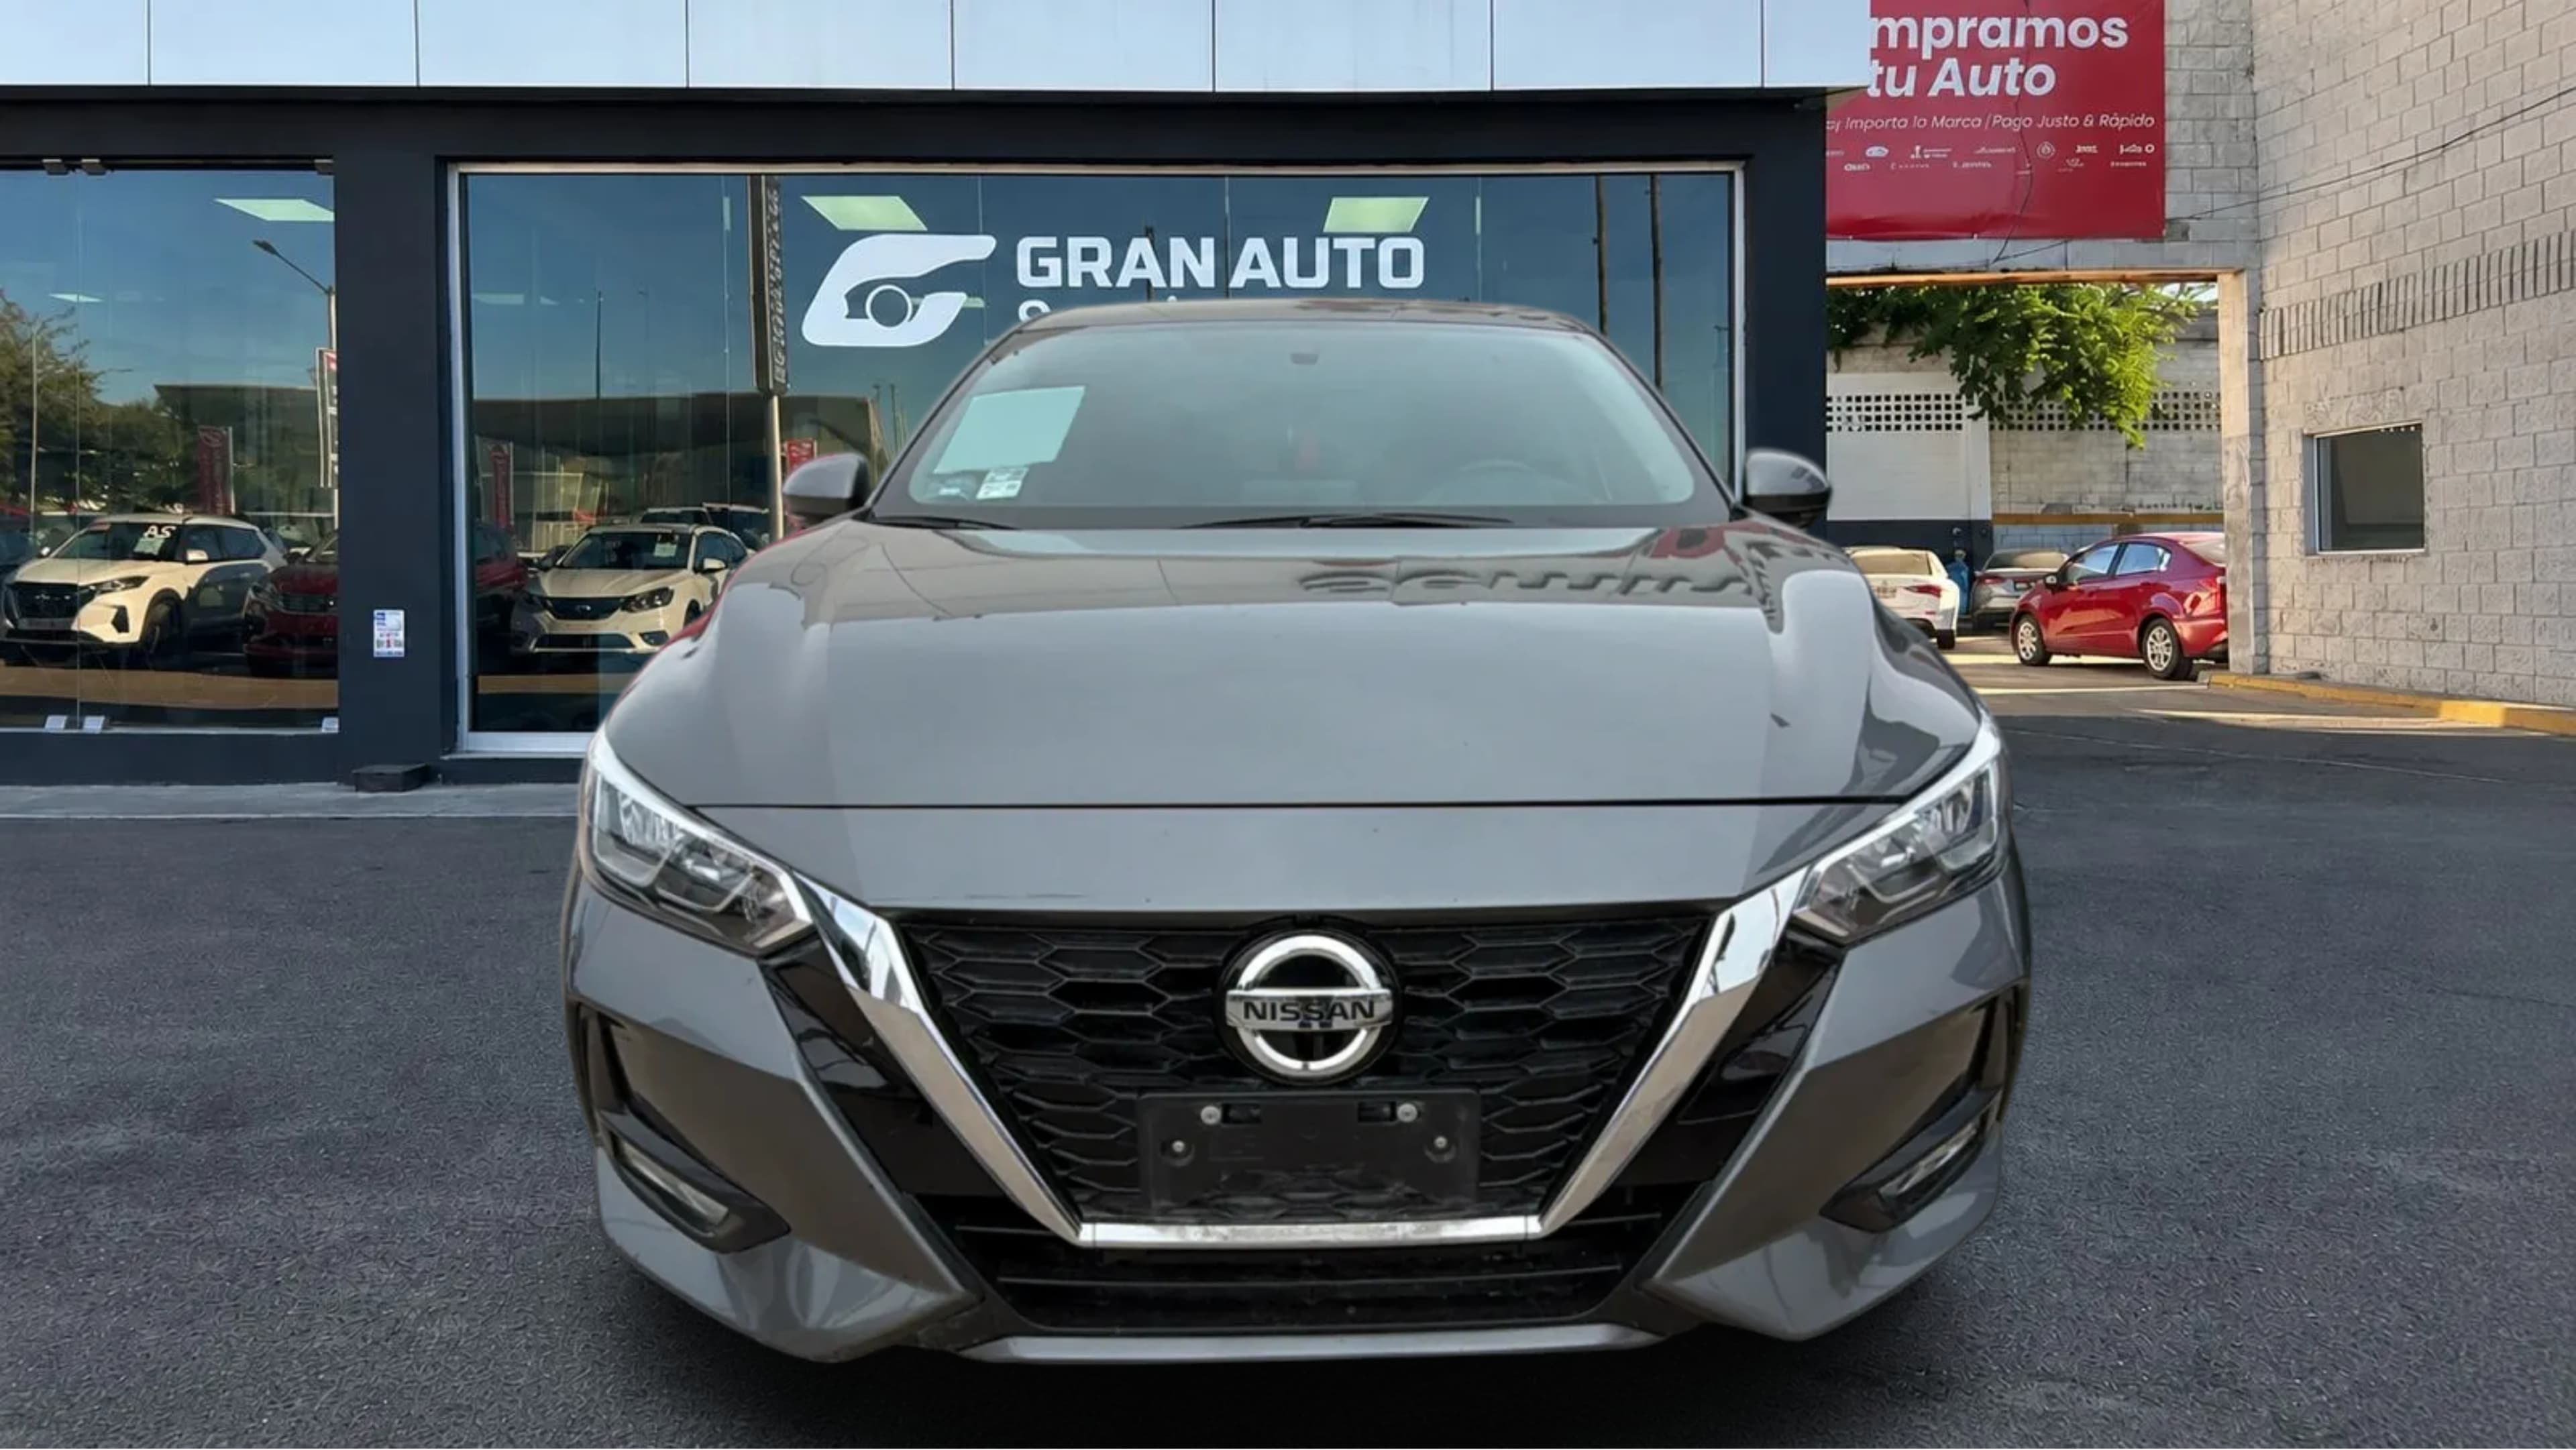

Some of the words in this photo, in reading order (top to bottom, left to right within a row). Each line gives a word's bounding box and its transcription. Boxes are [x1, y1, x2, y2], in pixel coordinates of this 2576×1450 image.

[1870, 17, 2129, 59] mpramos
[1867, 58, 1917, 97] tu
[1927, 57, 2056, 97] Auto
[2037, 115, 2079, 128] Justo
[2083, 113, 2094, 127] &
[1018, 237, 1215, 288] GRAN
[1228, 237, 1424, 288] AUTO
[1244, 1000, 1375, 1021] NISSAN
